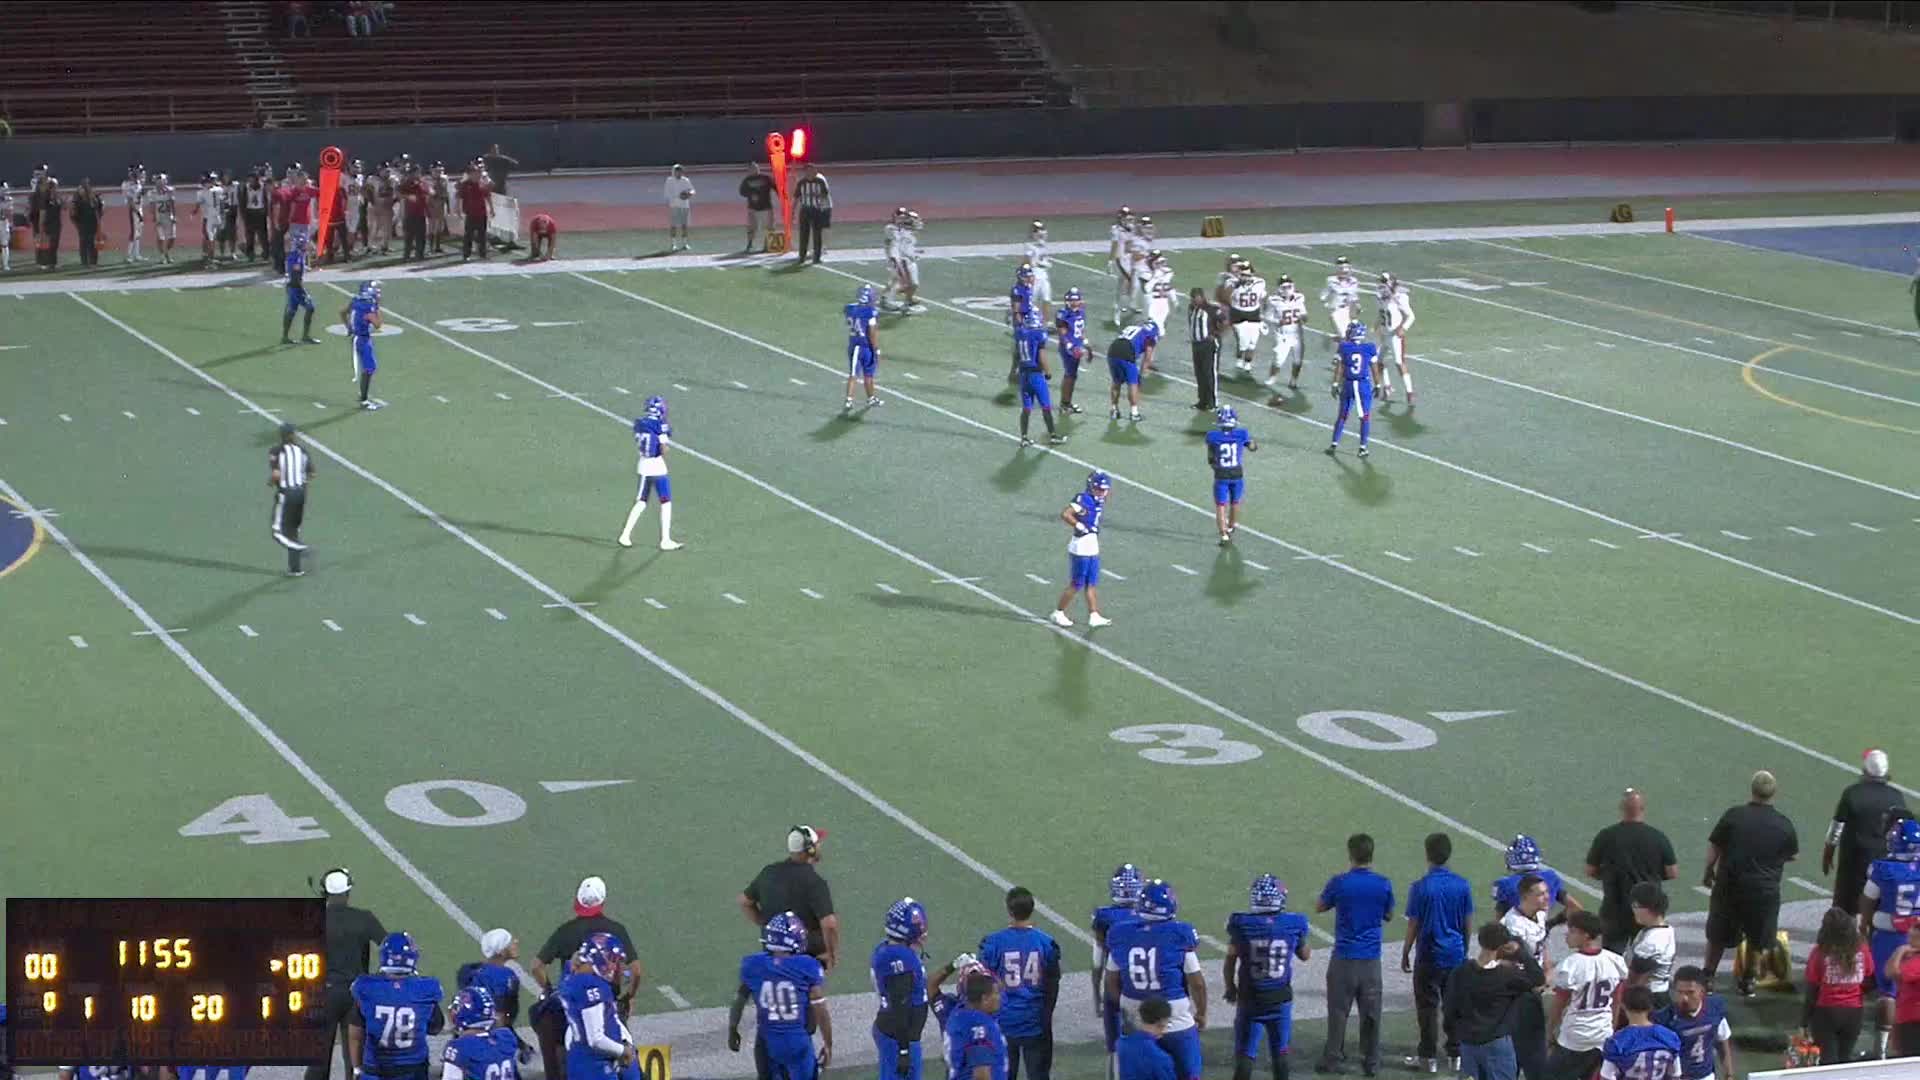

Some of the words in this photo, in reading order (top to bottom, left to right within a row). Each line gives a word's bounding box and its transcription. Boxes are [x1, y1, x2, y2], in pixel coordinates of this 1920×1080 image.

[1351, 353, 1363, 375] 3
[1219, 443, 1238, 468] 21
[1895, 884, 1920, 916] 5
[1003, 951, 1040, 988] 54
[1128, 947, 1162, 990] 61
[758, 980, 799, 1021] 40
[374, 1006, 416, 1048] 78
